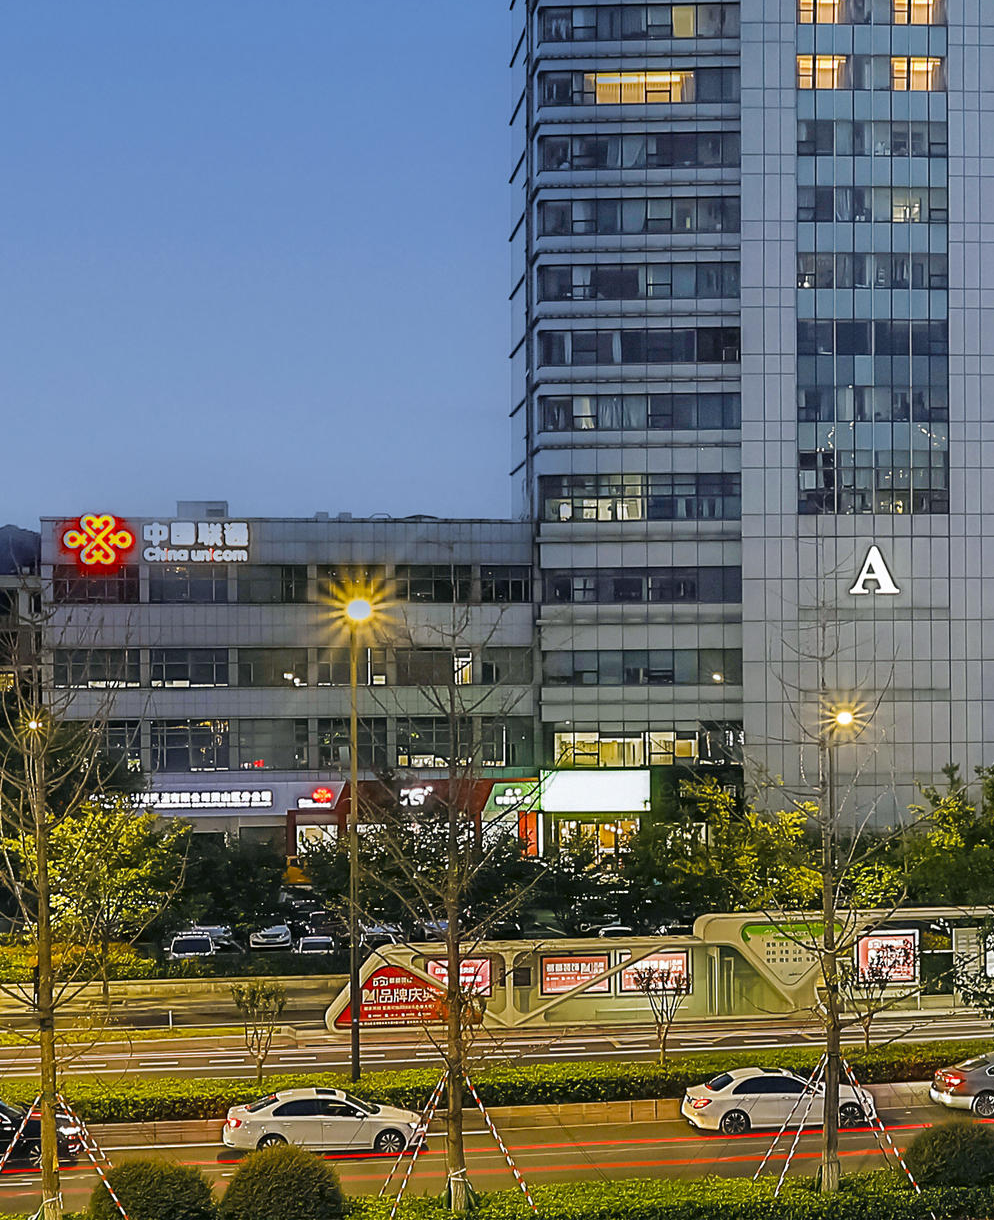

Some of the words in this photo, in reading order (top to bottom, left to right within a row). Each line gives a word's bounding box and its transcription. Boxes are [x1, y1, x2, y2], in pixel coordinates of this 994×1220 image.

[143, 522, 249, 547] 中国联通
[143, 546, 189, 562] China
[190, 547, 248, 562] unicom
[849, 545, 901, 595] A
